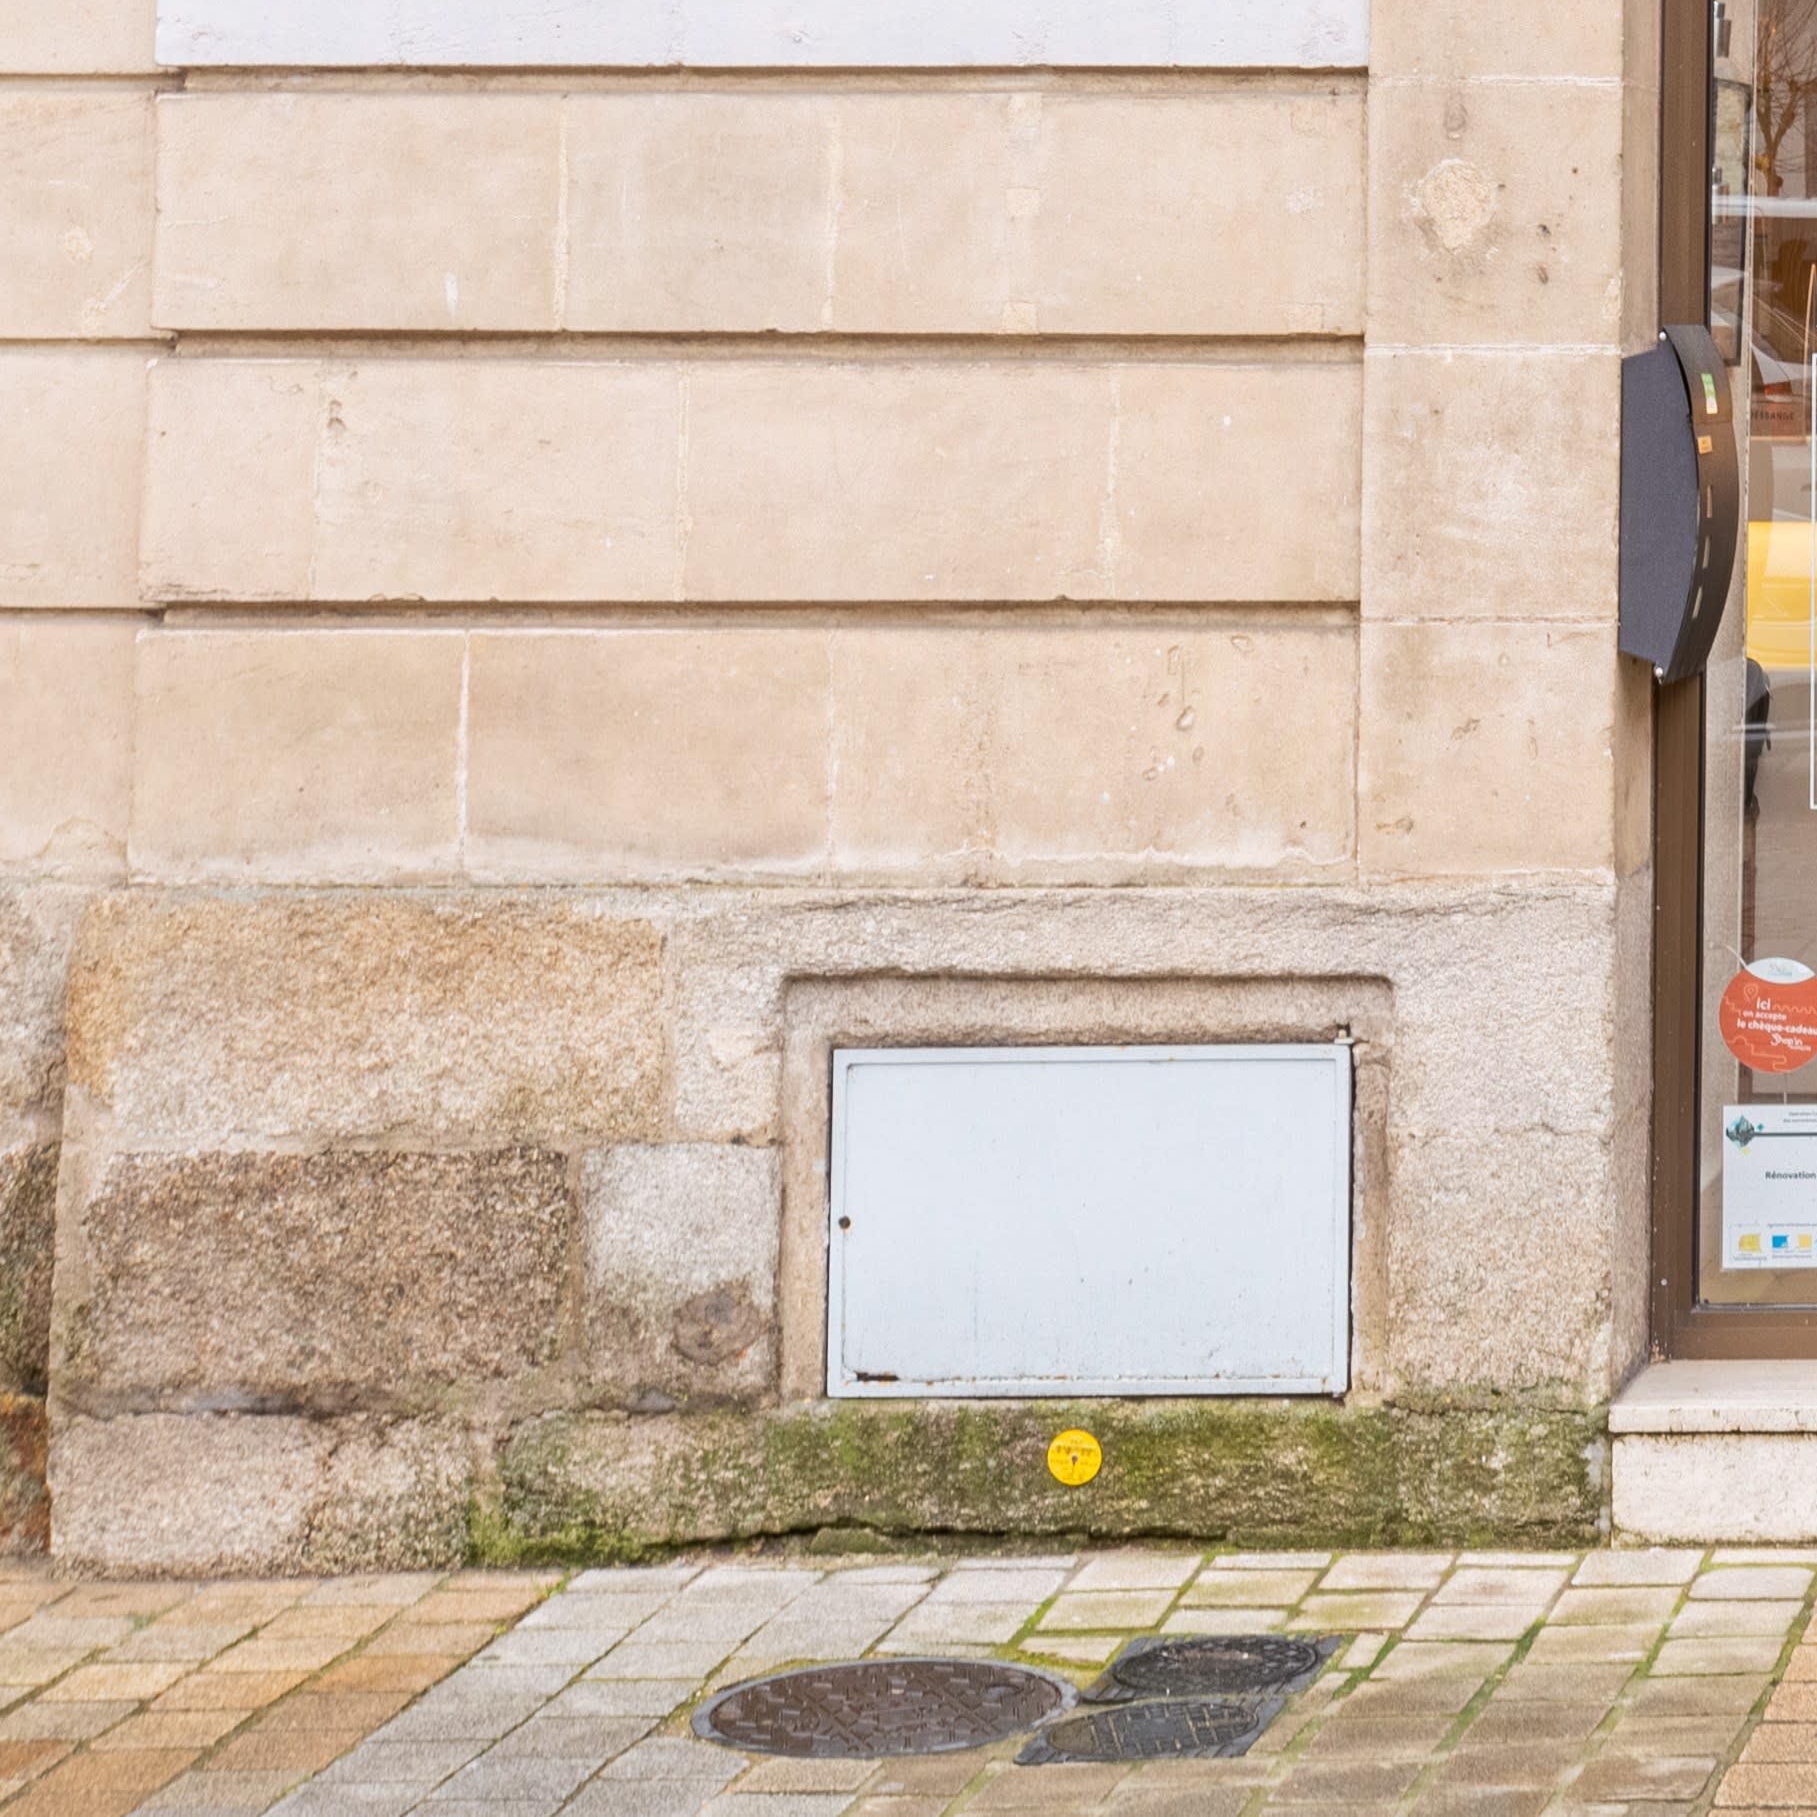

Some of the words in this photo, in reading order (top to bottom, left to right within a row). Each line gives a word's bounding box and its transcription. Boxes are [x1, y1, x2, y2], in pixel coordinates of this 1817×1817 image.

[1756, 997, 1771, 1011] Ici
[1737, 1018, 1747, 1029] le
[1765, 1170, 1817, 1181] Rénovation
